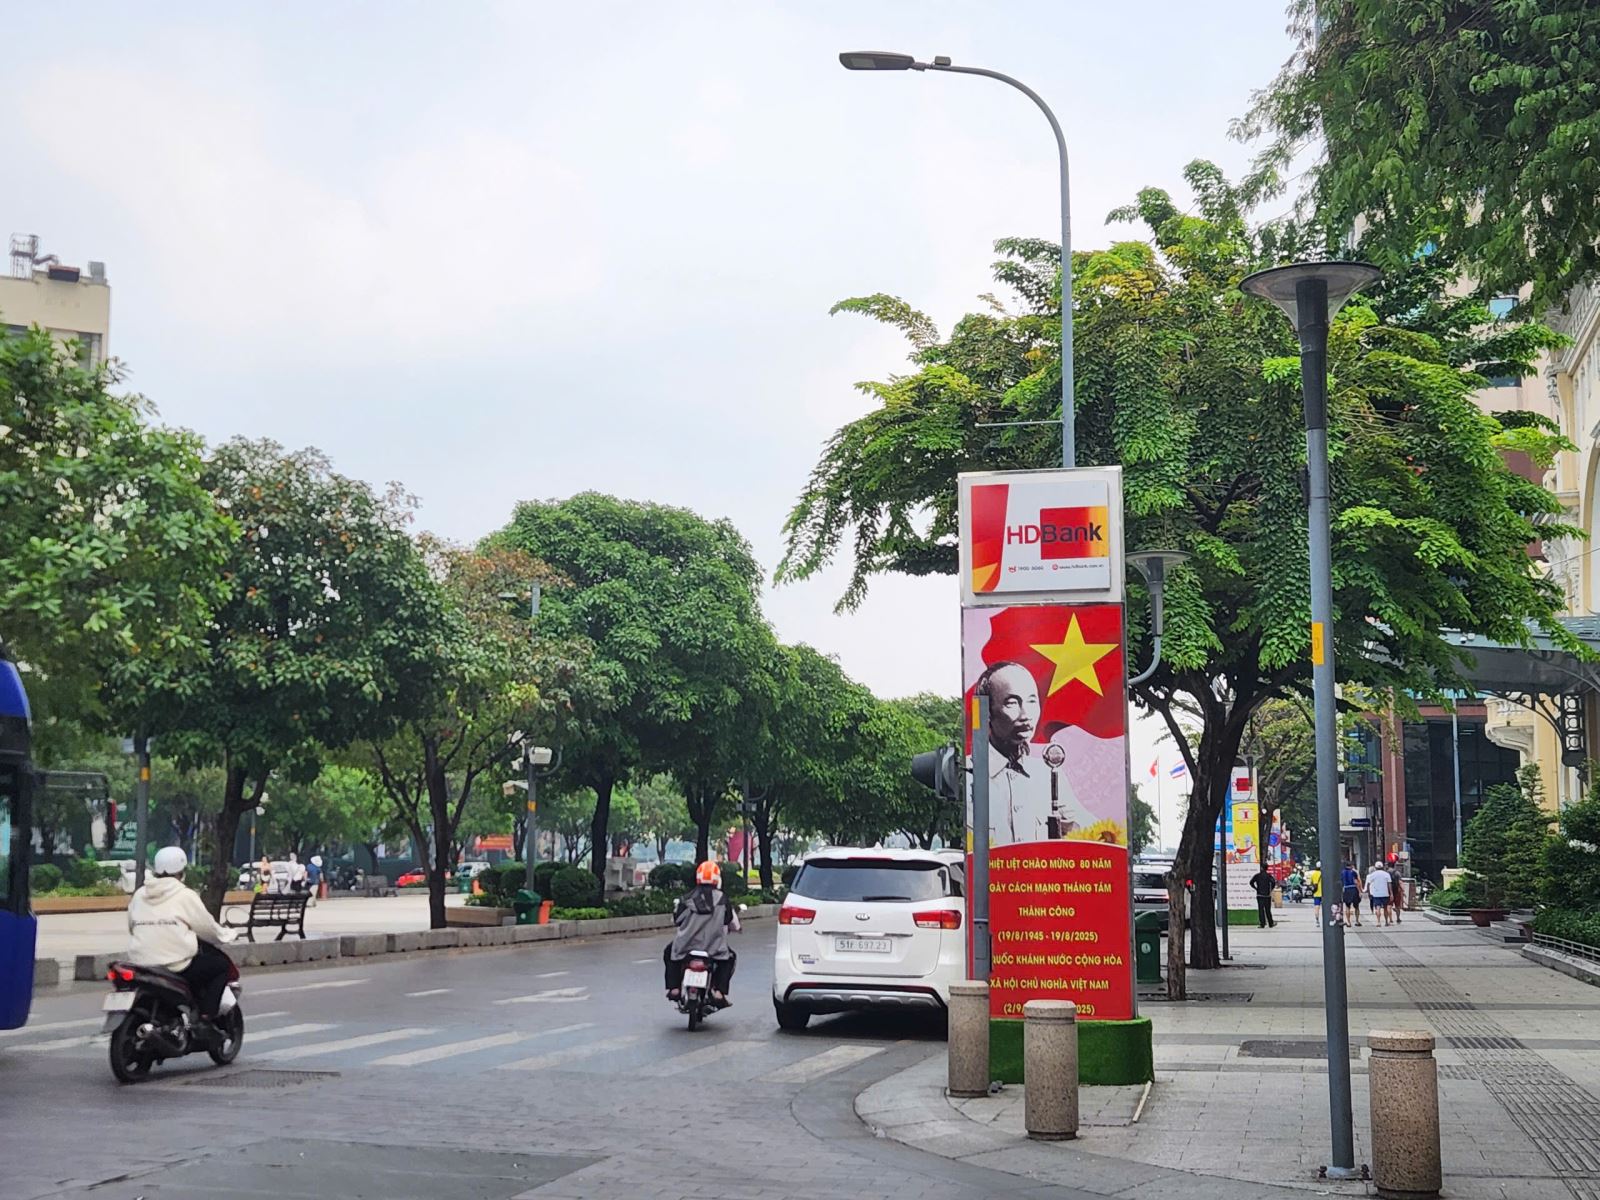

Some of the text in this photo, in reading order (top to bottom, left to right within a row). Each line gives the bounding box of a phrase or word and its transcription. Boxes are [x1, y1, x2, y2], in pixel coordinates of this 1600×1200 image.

[1007, 522, 1103, 545] HDBank
[988, 857, 1112, 871] HIỆT LIỆT CHÀO MỪNG 80 NĂM
[988, 881, 1112, 895] GÀY CÁCH MẠNG THÁNG TÁM
[1018, 905, 1075, 917] THÀNH CÔNG
[997, 931, 1044, 943] (19/8/1945
[1051, 931, 1098, 943] 19/8/2025)
[1016, 953, 1045, 965] KHÁNH
[1047, 953, 1073, 965] NƯỚC
[1075, 953, 1101, 968] CỘNG
[1103, 954, 1123, 966] HÒA
[1003, 977, 1018, 990] HỘI
[1070, 978, 1088, 992] VIỆT
[1089, 980, 1109, 990] NAM
[1003, 1003, 1024, 1015] (2/9/
